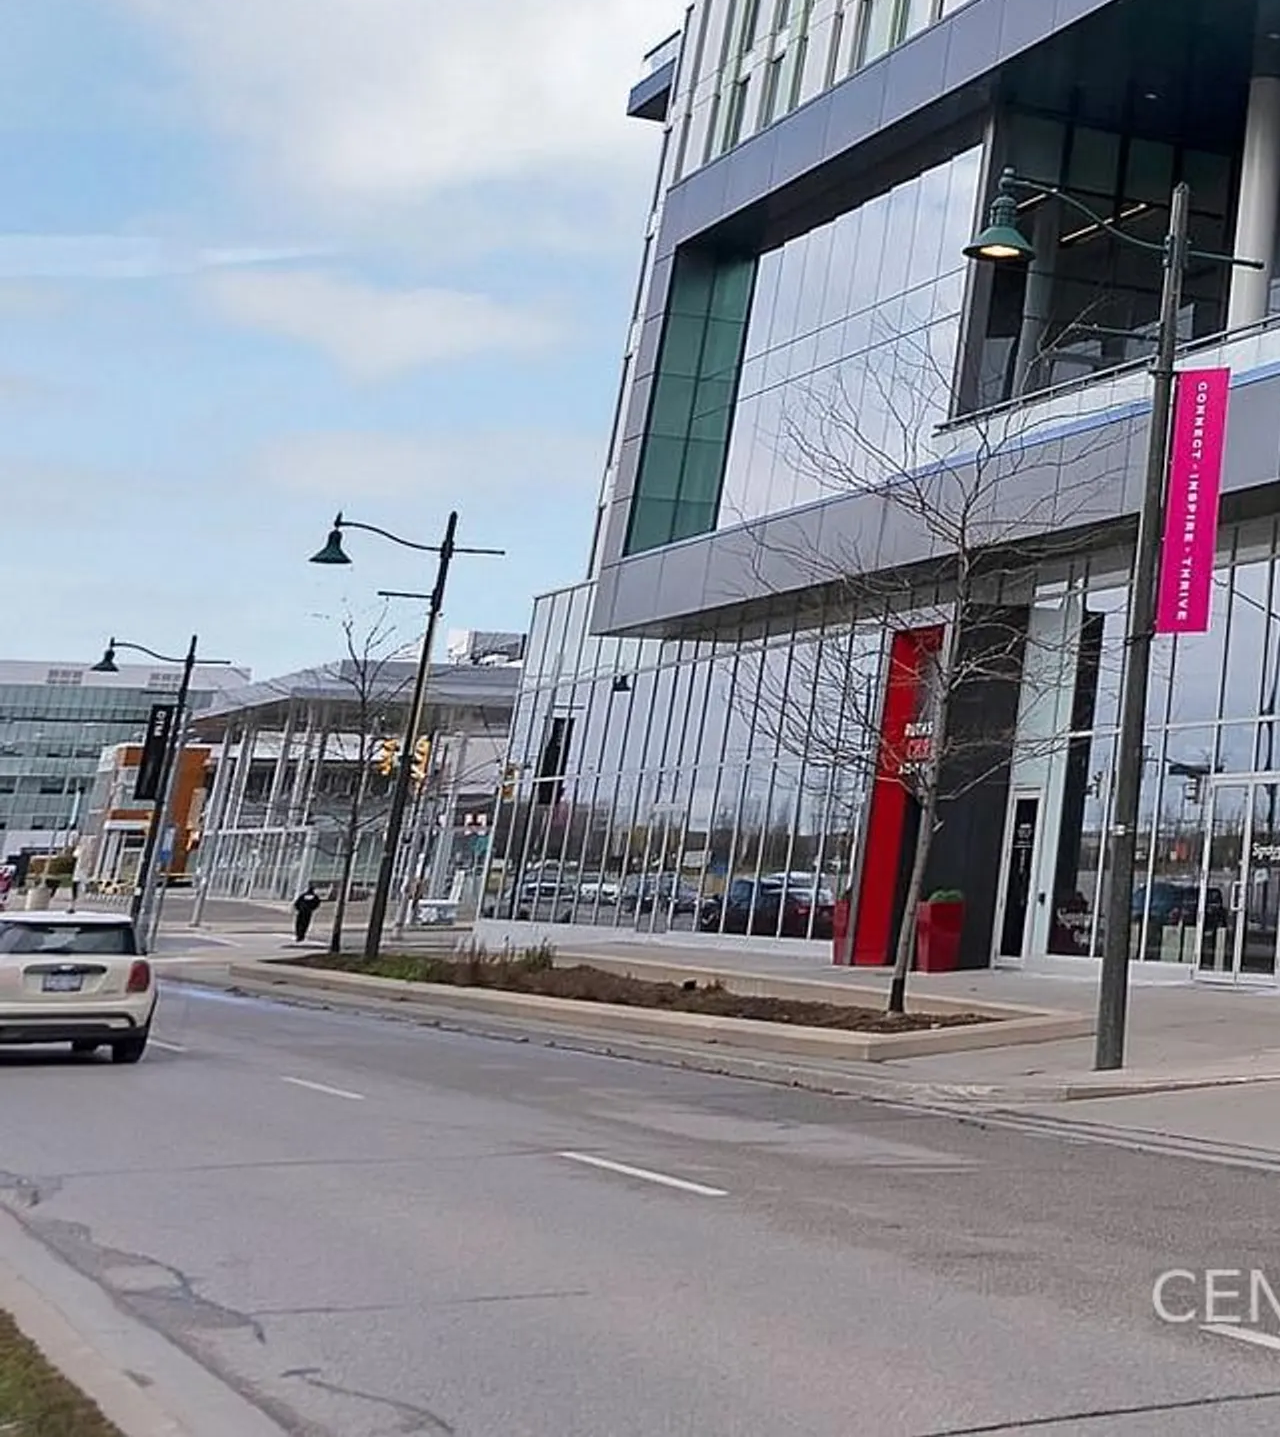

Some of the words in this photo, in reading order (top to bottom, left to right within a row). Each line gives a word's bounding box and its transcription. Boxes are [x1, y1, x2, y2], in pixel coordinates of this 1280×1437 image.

[1191, 381, 1208, 459] CONNECT
[1183, 473, 1200, 543] INSPIRE
[1176, 558, 1193, 621] THRIVE
